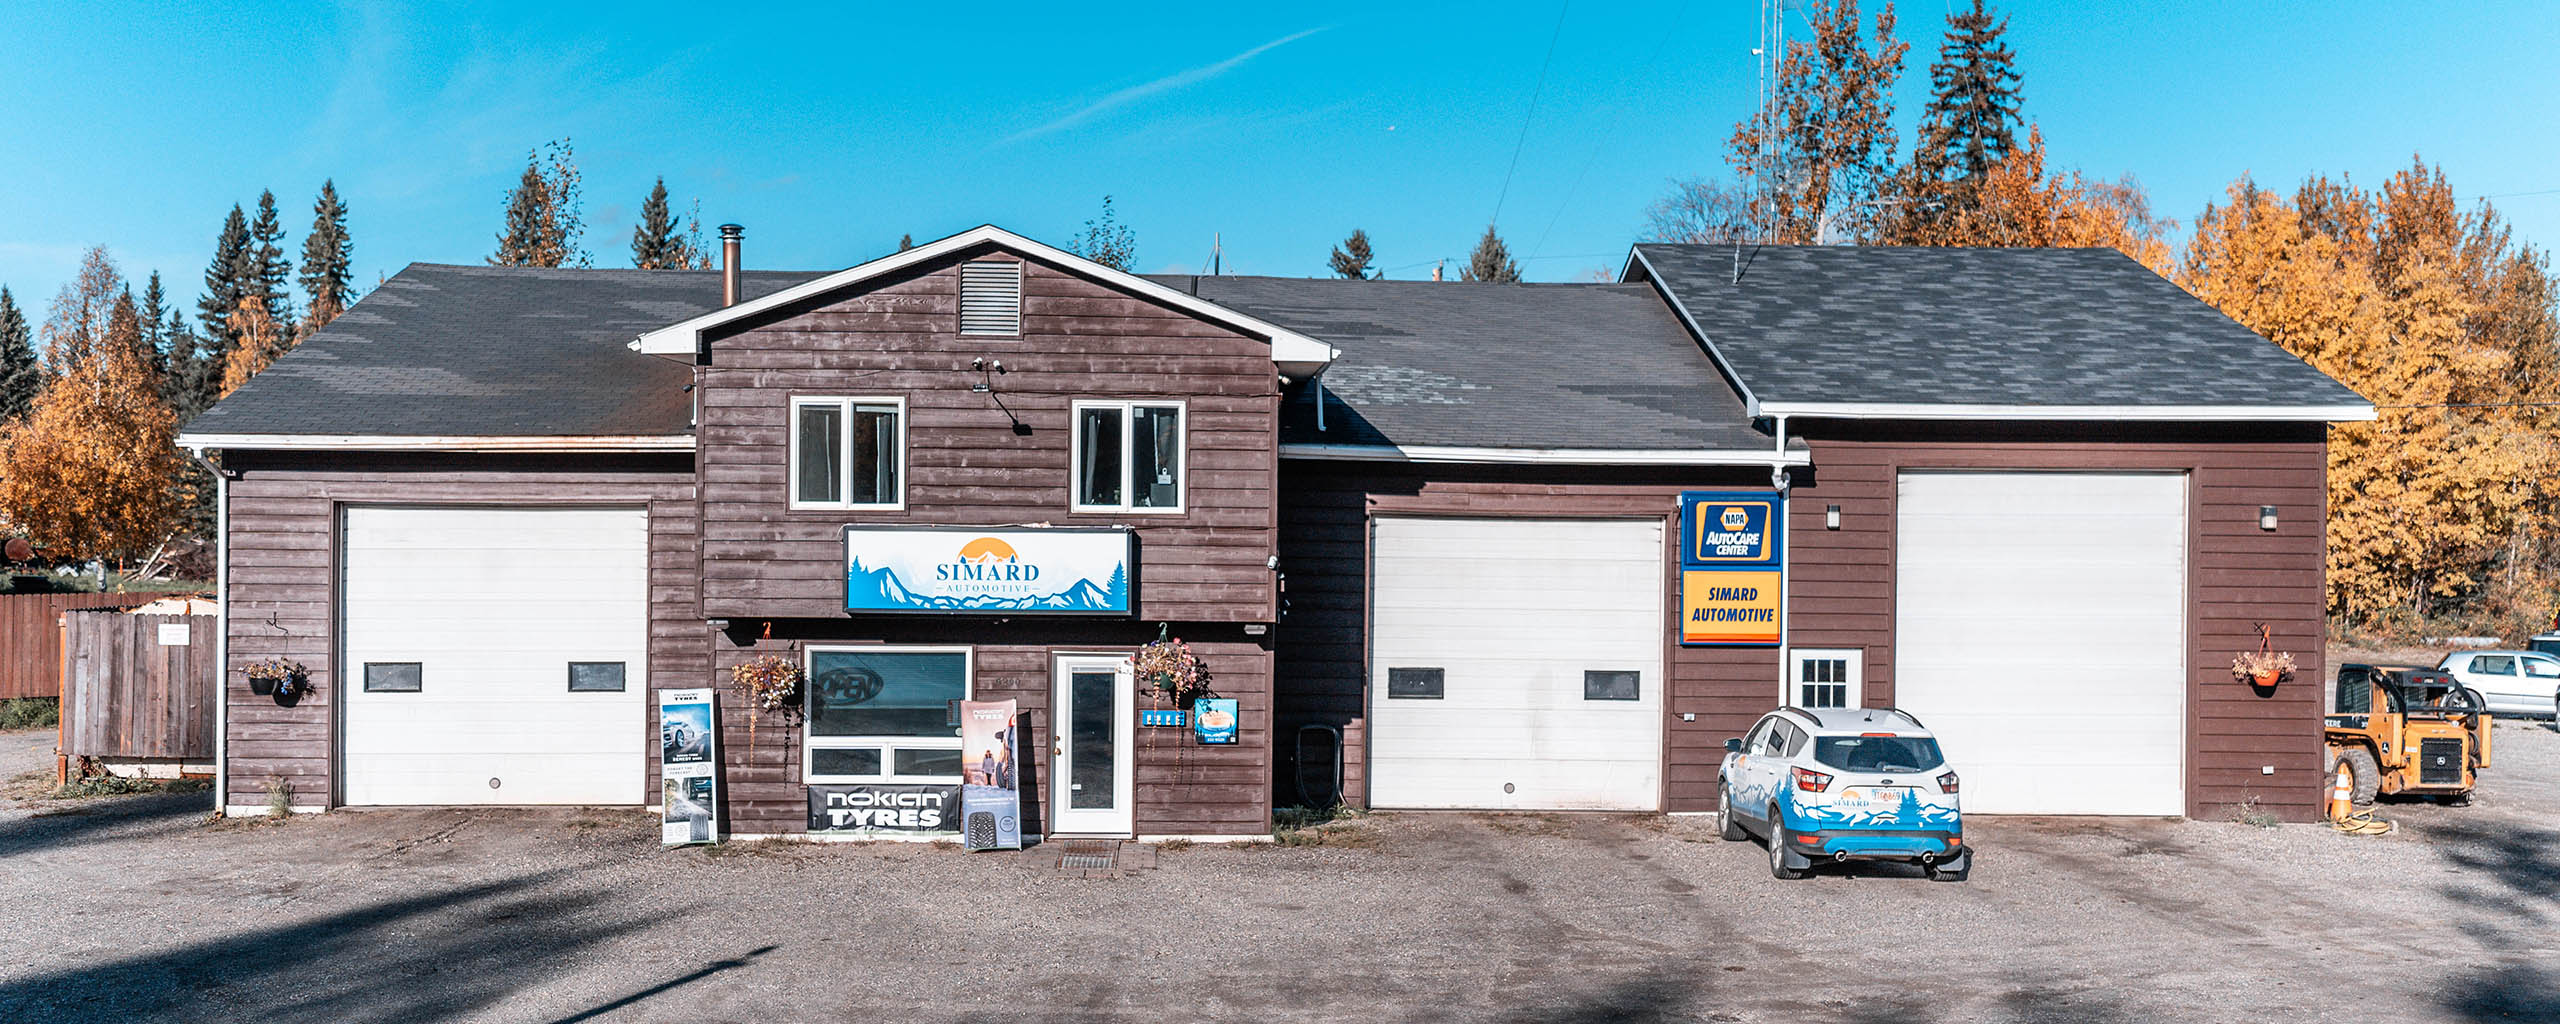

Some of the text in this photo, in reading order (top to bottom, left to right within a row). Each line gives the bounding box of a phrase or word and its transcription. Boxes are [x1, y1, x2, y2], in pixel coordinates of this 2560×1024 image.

[1725, 513, 1745, 525] NAPA
[1716, 545, 1749, 555] CENTER
[936, 563, 1040, 581] SIMARD
[946, 584, 1030, 593] AUTOMOTIVE
[1708, 587, 1758, 601] SIMARD
[1692, 608, 1774, 622] AUTOMOTIVE
[820, 672, 876, 701] OPEN
[1833, 799, 1870, 807] SIMARD
[826, 808, 942, 827] TYRES
